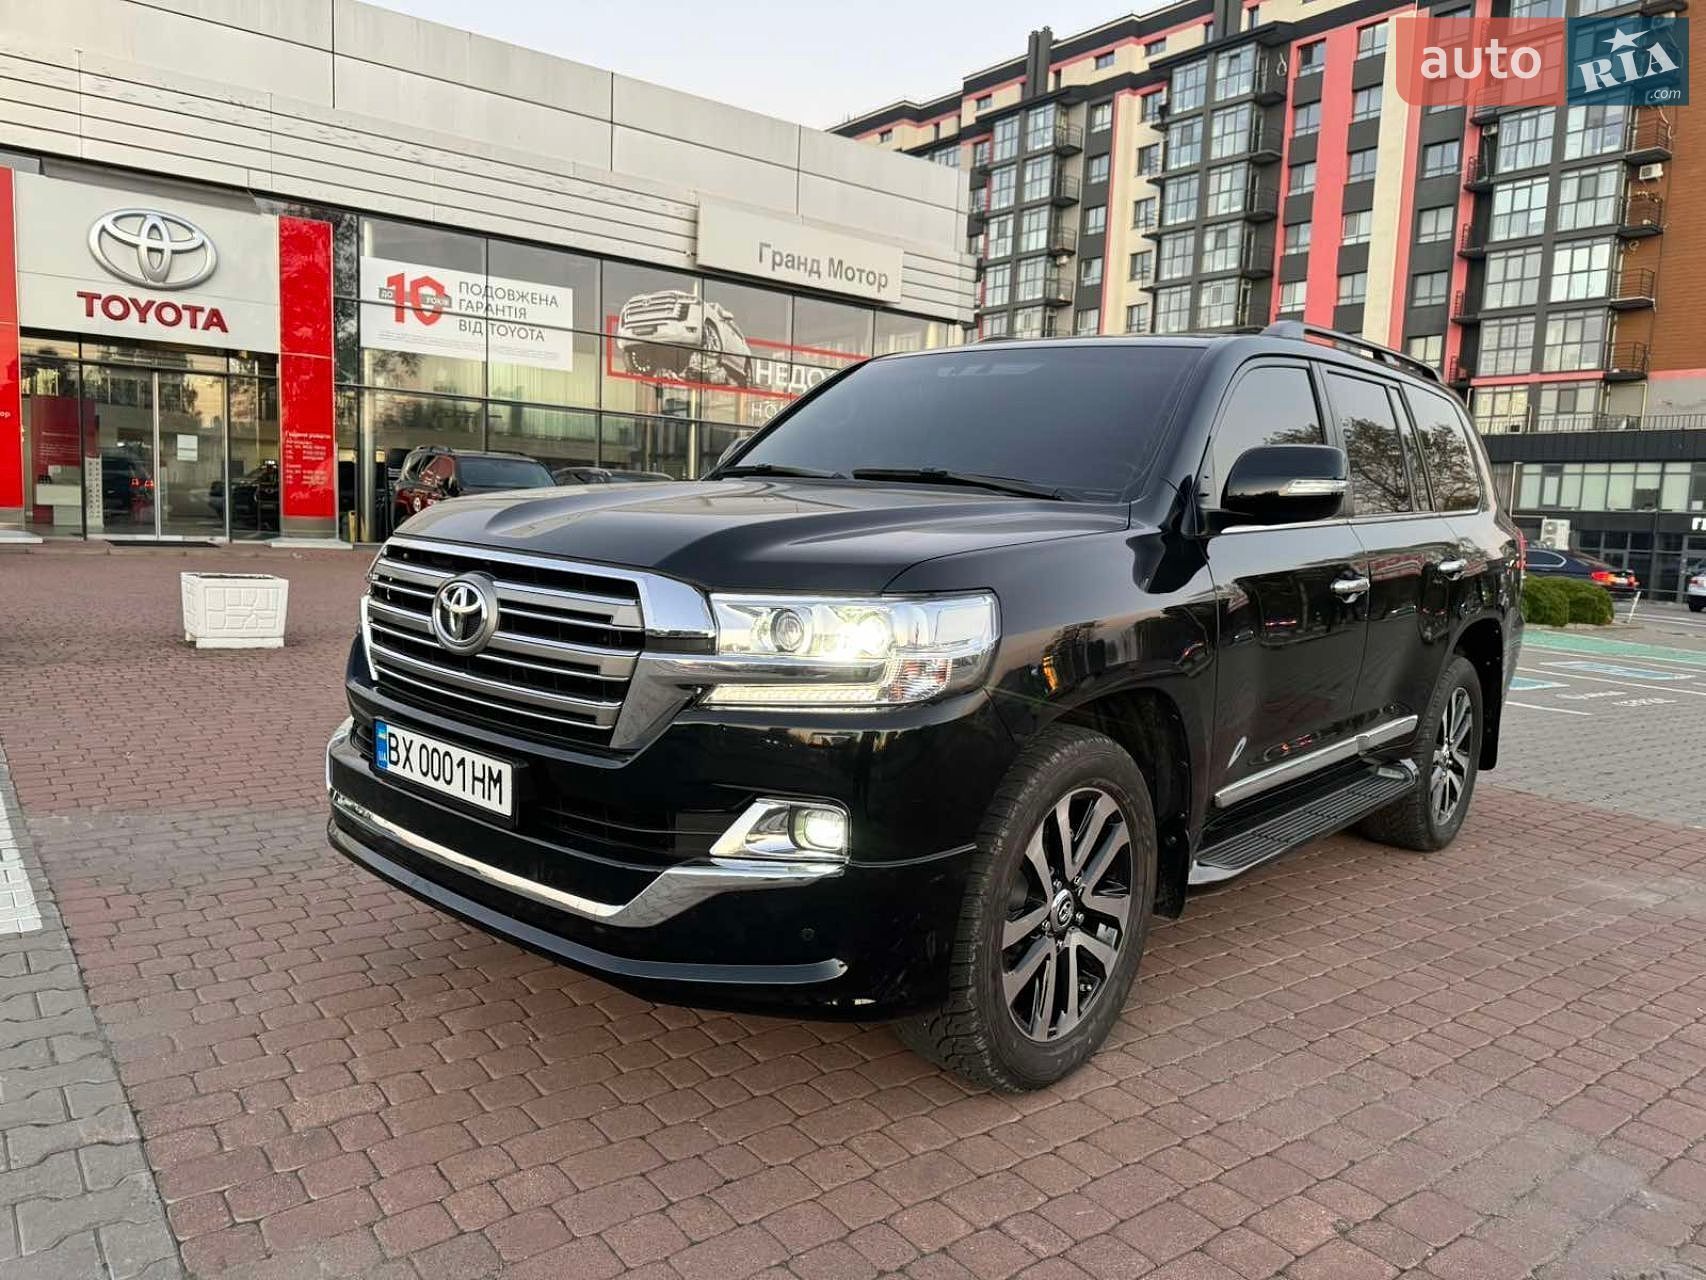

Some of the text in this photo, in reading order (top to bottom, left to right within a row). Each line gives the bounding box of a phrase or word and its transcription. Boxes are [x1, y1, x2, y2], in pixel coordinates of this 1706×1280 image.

[758, 241, 888, 293] Гранд Мотор
[77, 290, 229, 333] TOYOTA
[387, 272, 446, 326] 10
[458, 280, 559, 308] ПОДОВЖЕНА
[458, 298, 527, 320] ГАРАНТІЯ
[458, 319, 484, 336] ВІД
[488, 322, 545, 342] TOYOTA
